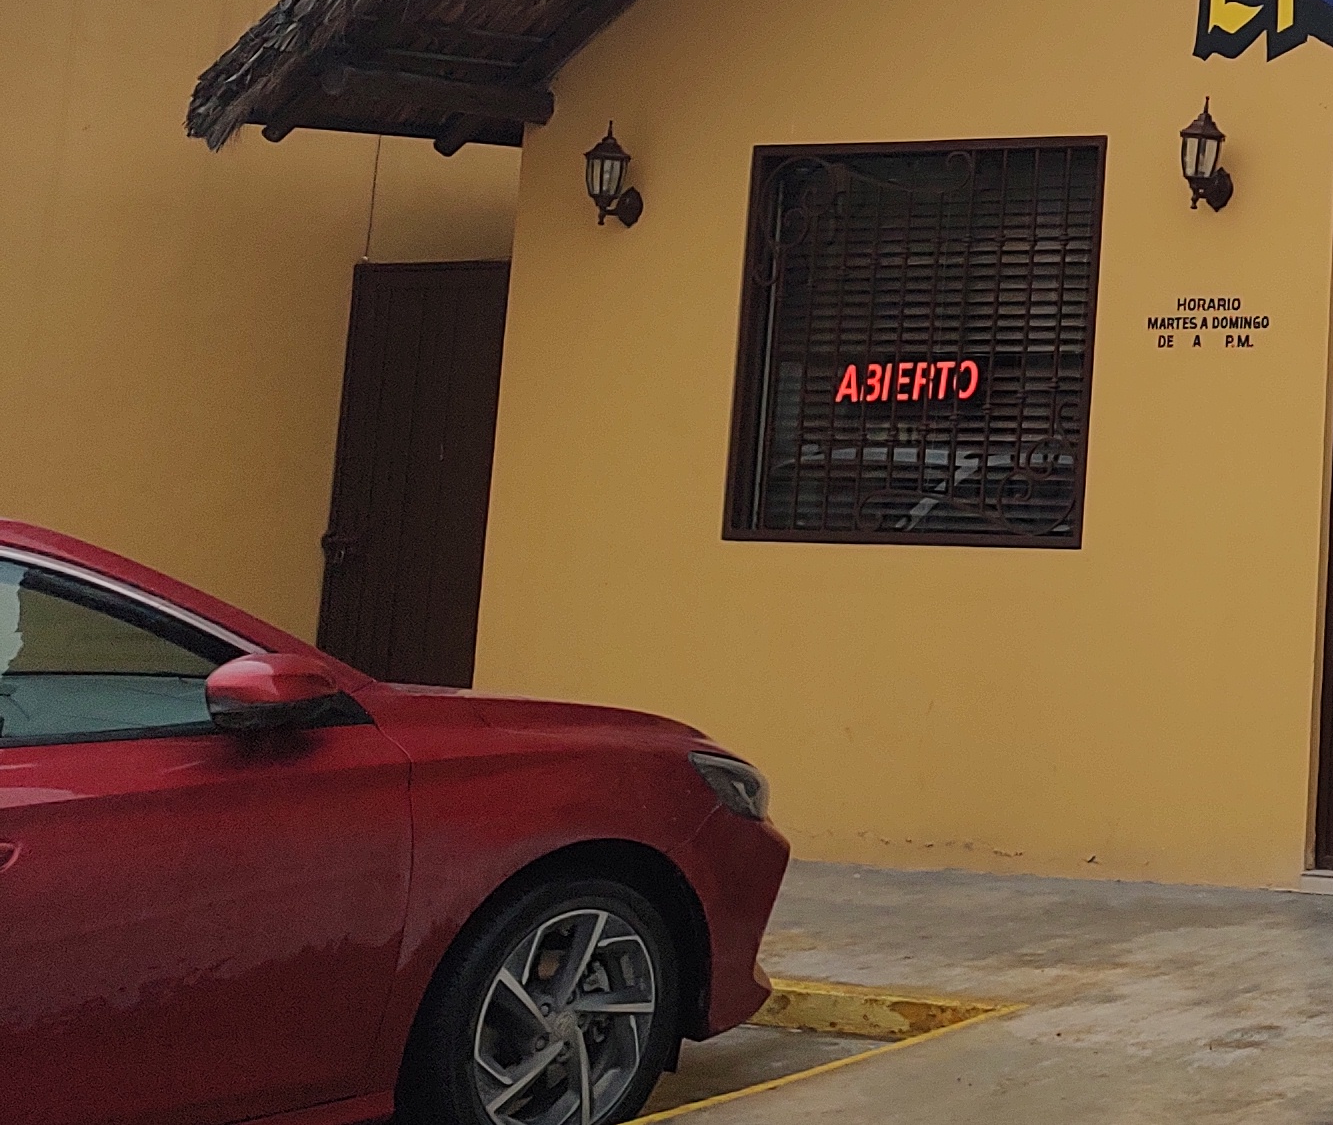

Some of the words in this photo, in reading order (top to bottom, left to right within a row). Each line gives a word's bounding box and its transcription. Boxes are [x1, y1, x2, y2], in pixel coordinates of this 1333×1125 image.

[1176, 297, 1241, 312] HORARIO
[1147, 316, 1198, 330] MARTES
[1199, 316, 1208, 330] A
[1211, 315, 1270, 329] DOMINGO
[1157, 334, 1174, 348] DE
[1192, 334, 1202, 348] A
[1225, 334, 1254, 348] P.M.
[834, 359, 980, 403] ABIERTO
